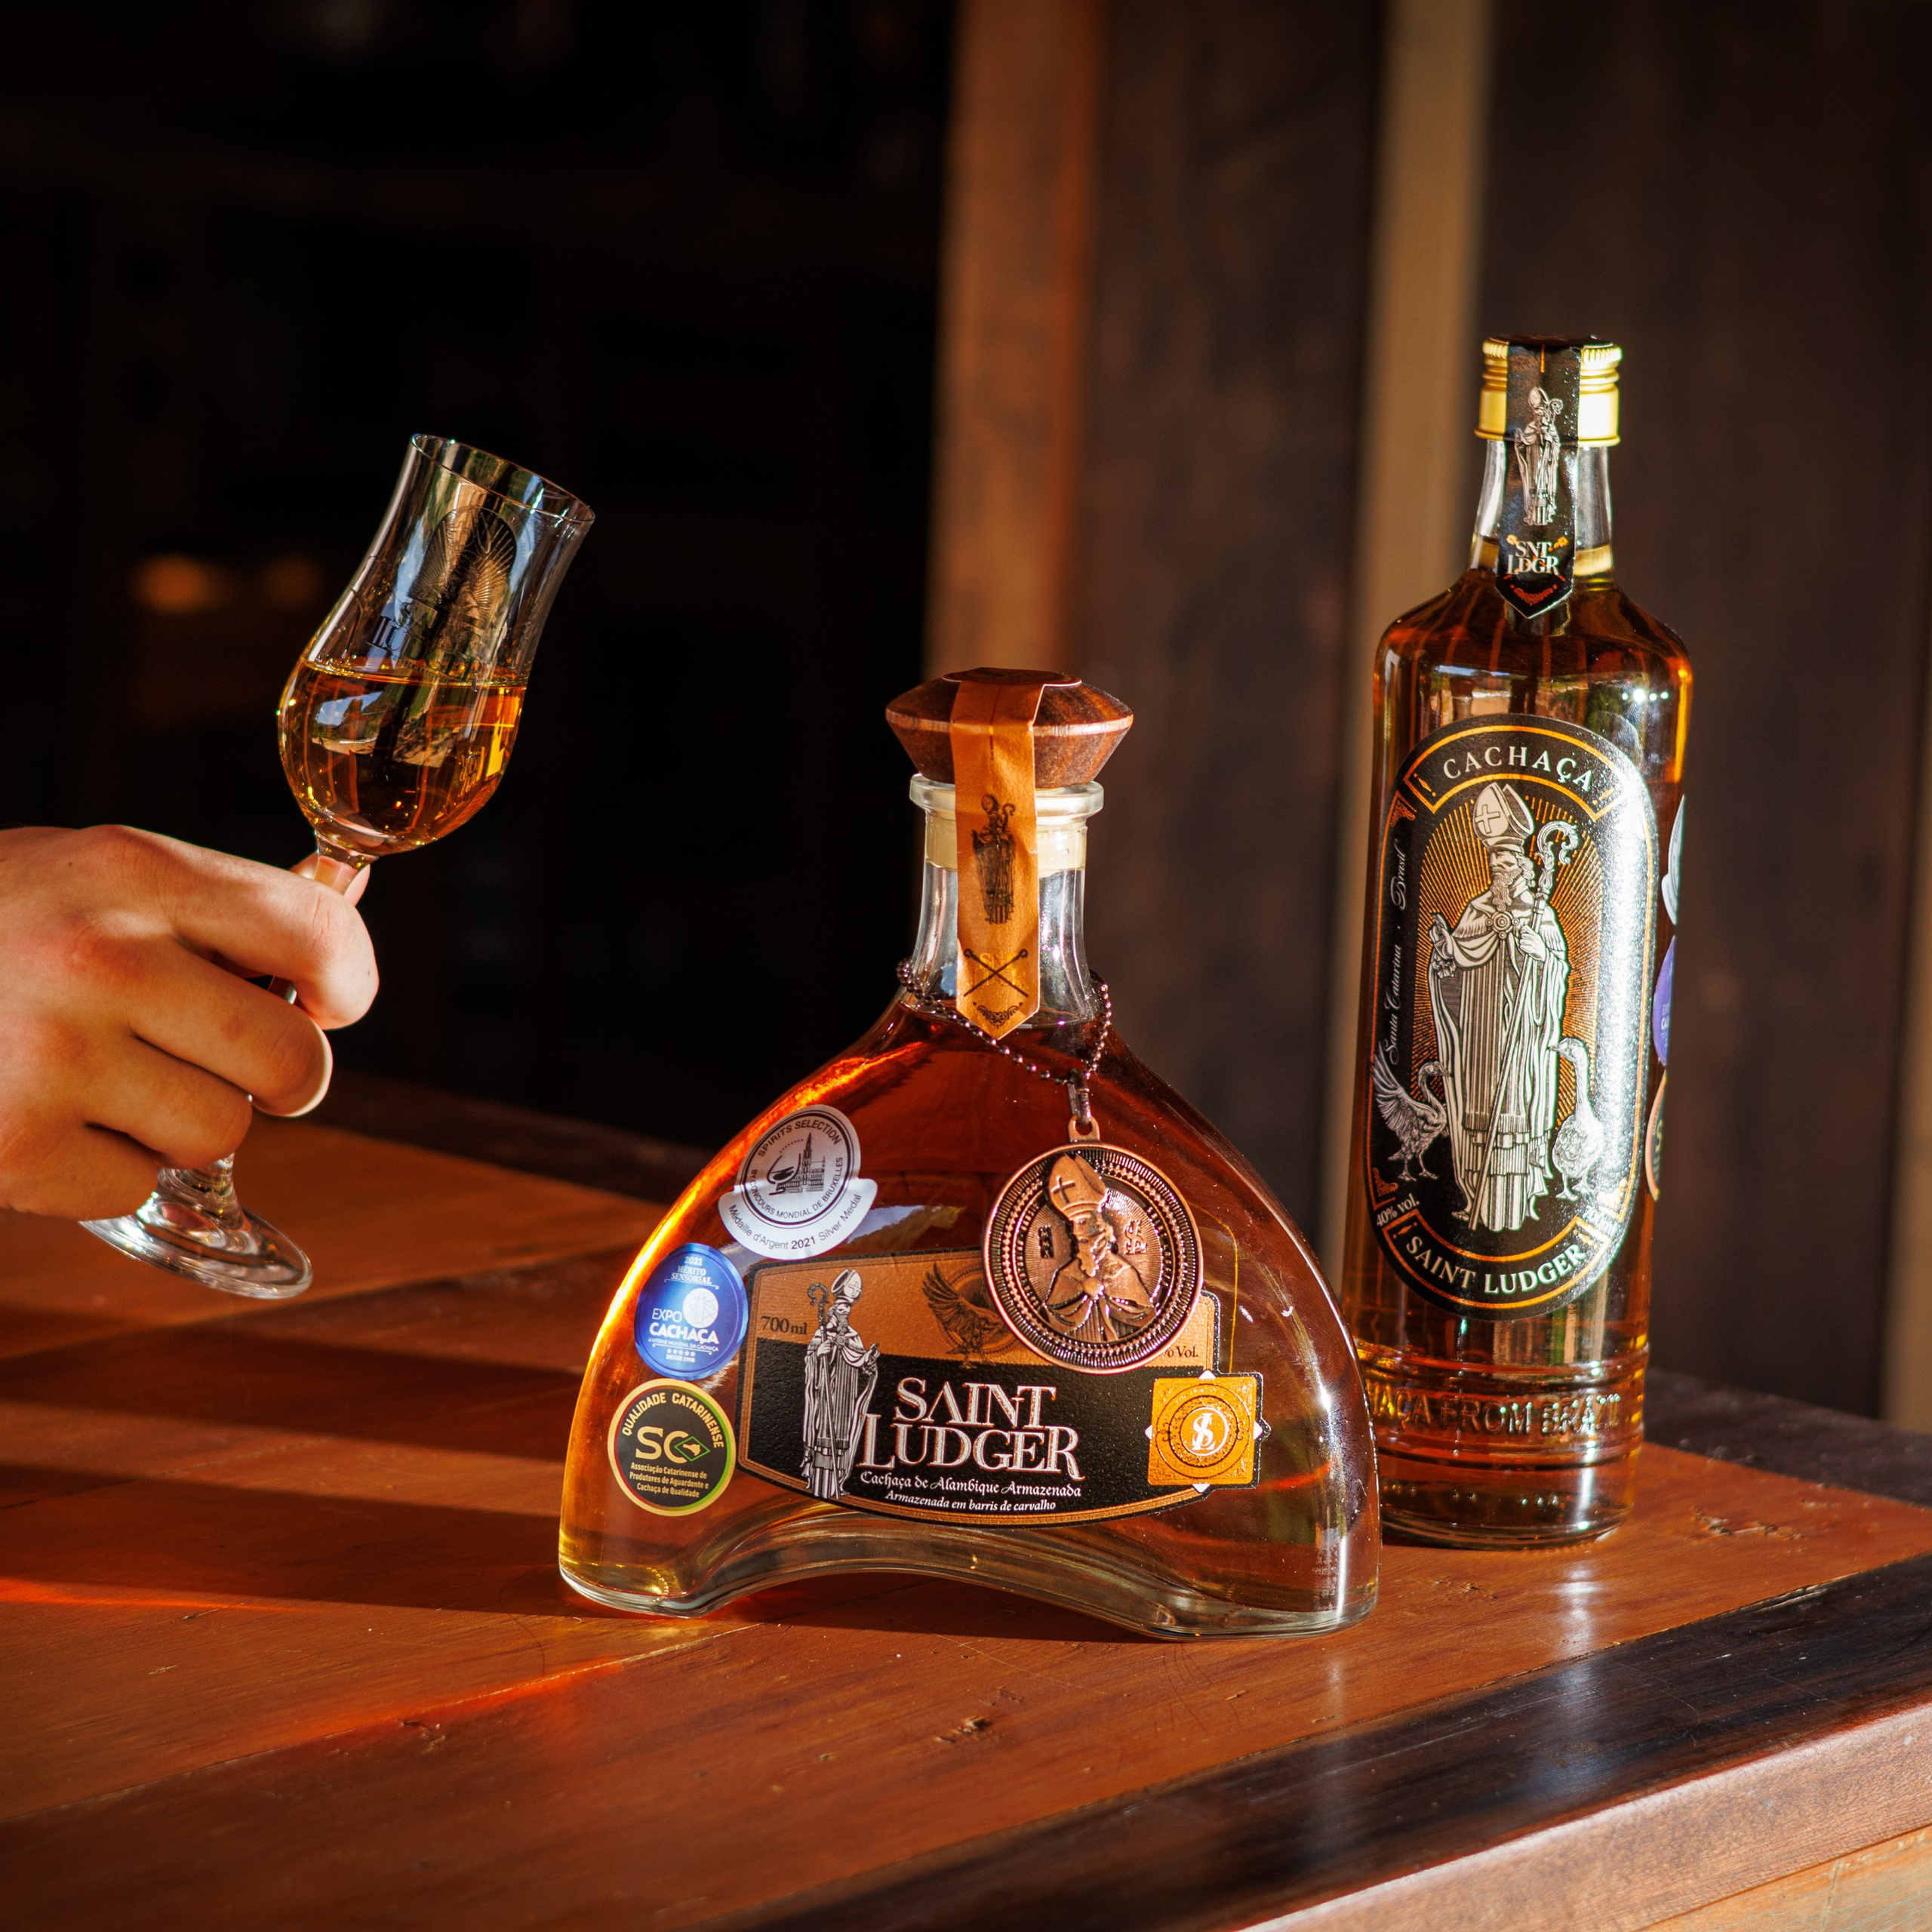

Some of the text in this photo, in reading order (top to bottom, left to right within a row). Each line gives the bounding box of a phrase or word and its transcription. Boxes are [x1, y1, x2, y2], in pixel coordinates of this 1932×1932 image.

[1515, 541, 1552, 558] SNT
[1506, 555, 1559, 576] LDGR
[1443, 746, 1595, 792] CACHAÇA
[1384, 838, 1407, 1065] Santa Catarina Brasil
[758, 1119, 841, 1157] SPIRITS SELECTION
[750, 1180, 775, 1215] CONCOURS
[775, 1208, 812, 1219] MONDIAL
[812, 1201, 823, 1212] DE
[822, 1157, 843, 1204] BRUXELLES
[728, 1194, 862, 1250] Médaille d'Argent 2021 Silver Medal
[1377, 1192, 1420, 1226] 40% vol.
[677, 1265, 706, 1275] MÉRITO
[685, 1256, 703, 1266] 2021
[1405, 1235, 1587, 1296] SAINT LUDGER
[671, 1272, 712, 1284] SENSORIAL
[651, 1308, 682, 1323] EXPO
[649, 1322, 719, 1344] CACHAÇA
[1175, 1344, 1198, 1358] Vol.
[893, 1377, 1057, 1429] SAINT
[1440, 1394, 1531, 1433] FROM
[622, 1392, 724, 1448] QUALIDADE CATARINENSE
[635, 1426, 689, 1464] SC
[856, 1413, 1086, 1481] LUDGER
[629, 1472, 660, 1484] Produtores
[670, 1478, 703, 1488] Aguardente
[631, 1462, 707, 1479] Associação Catarinense de
[860, 1470, 1081, 1497] Cachaça de Alambique Armazenada
[637, 1482, 700, 1498] Cachaça de Qualidade
[885, 1489, 1056, 1511] Armazenada em barris de carvalho
